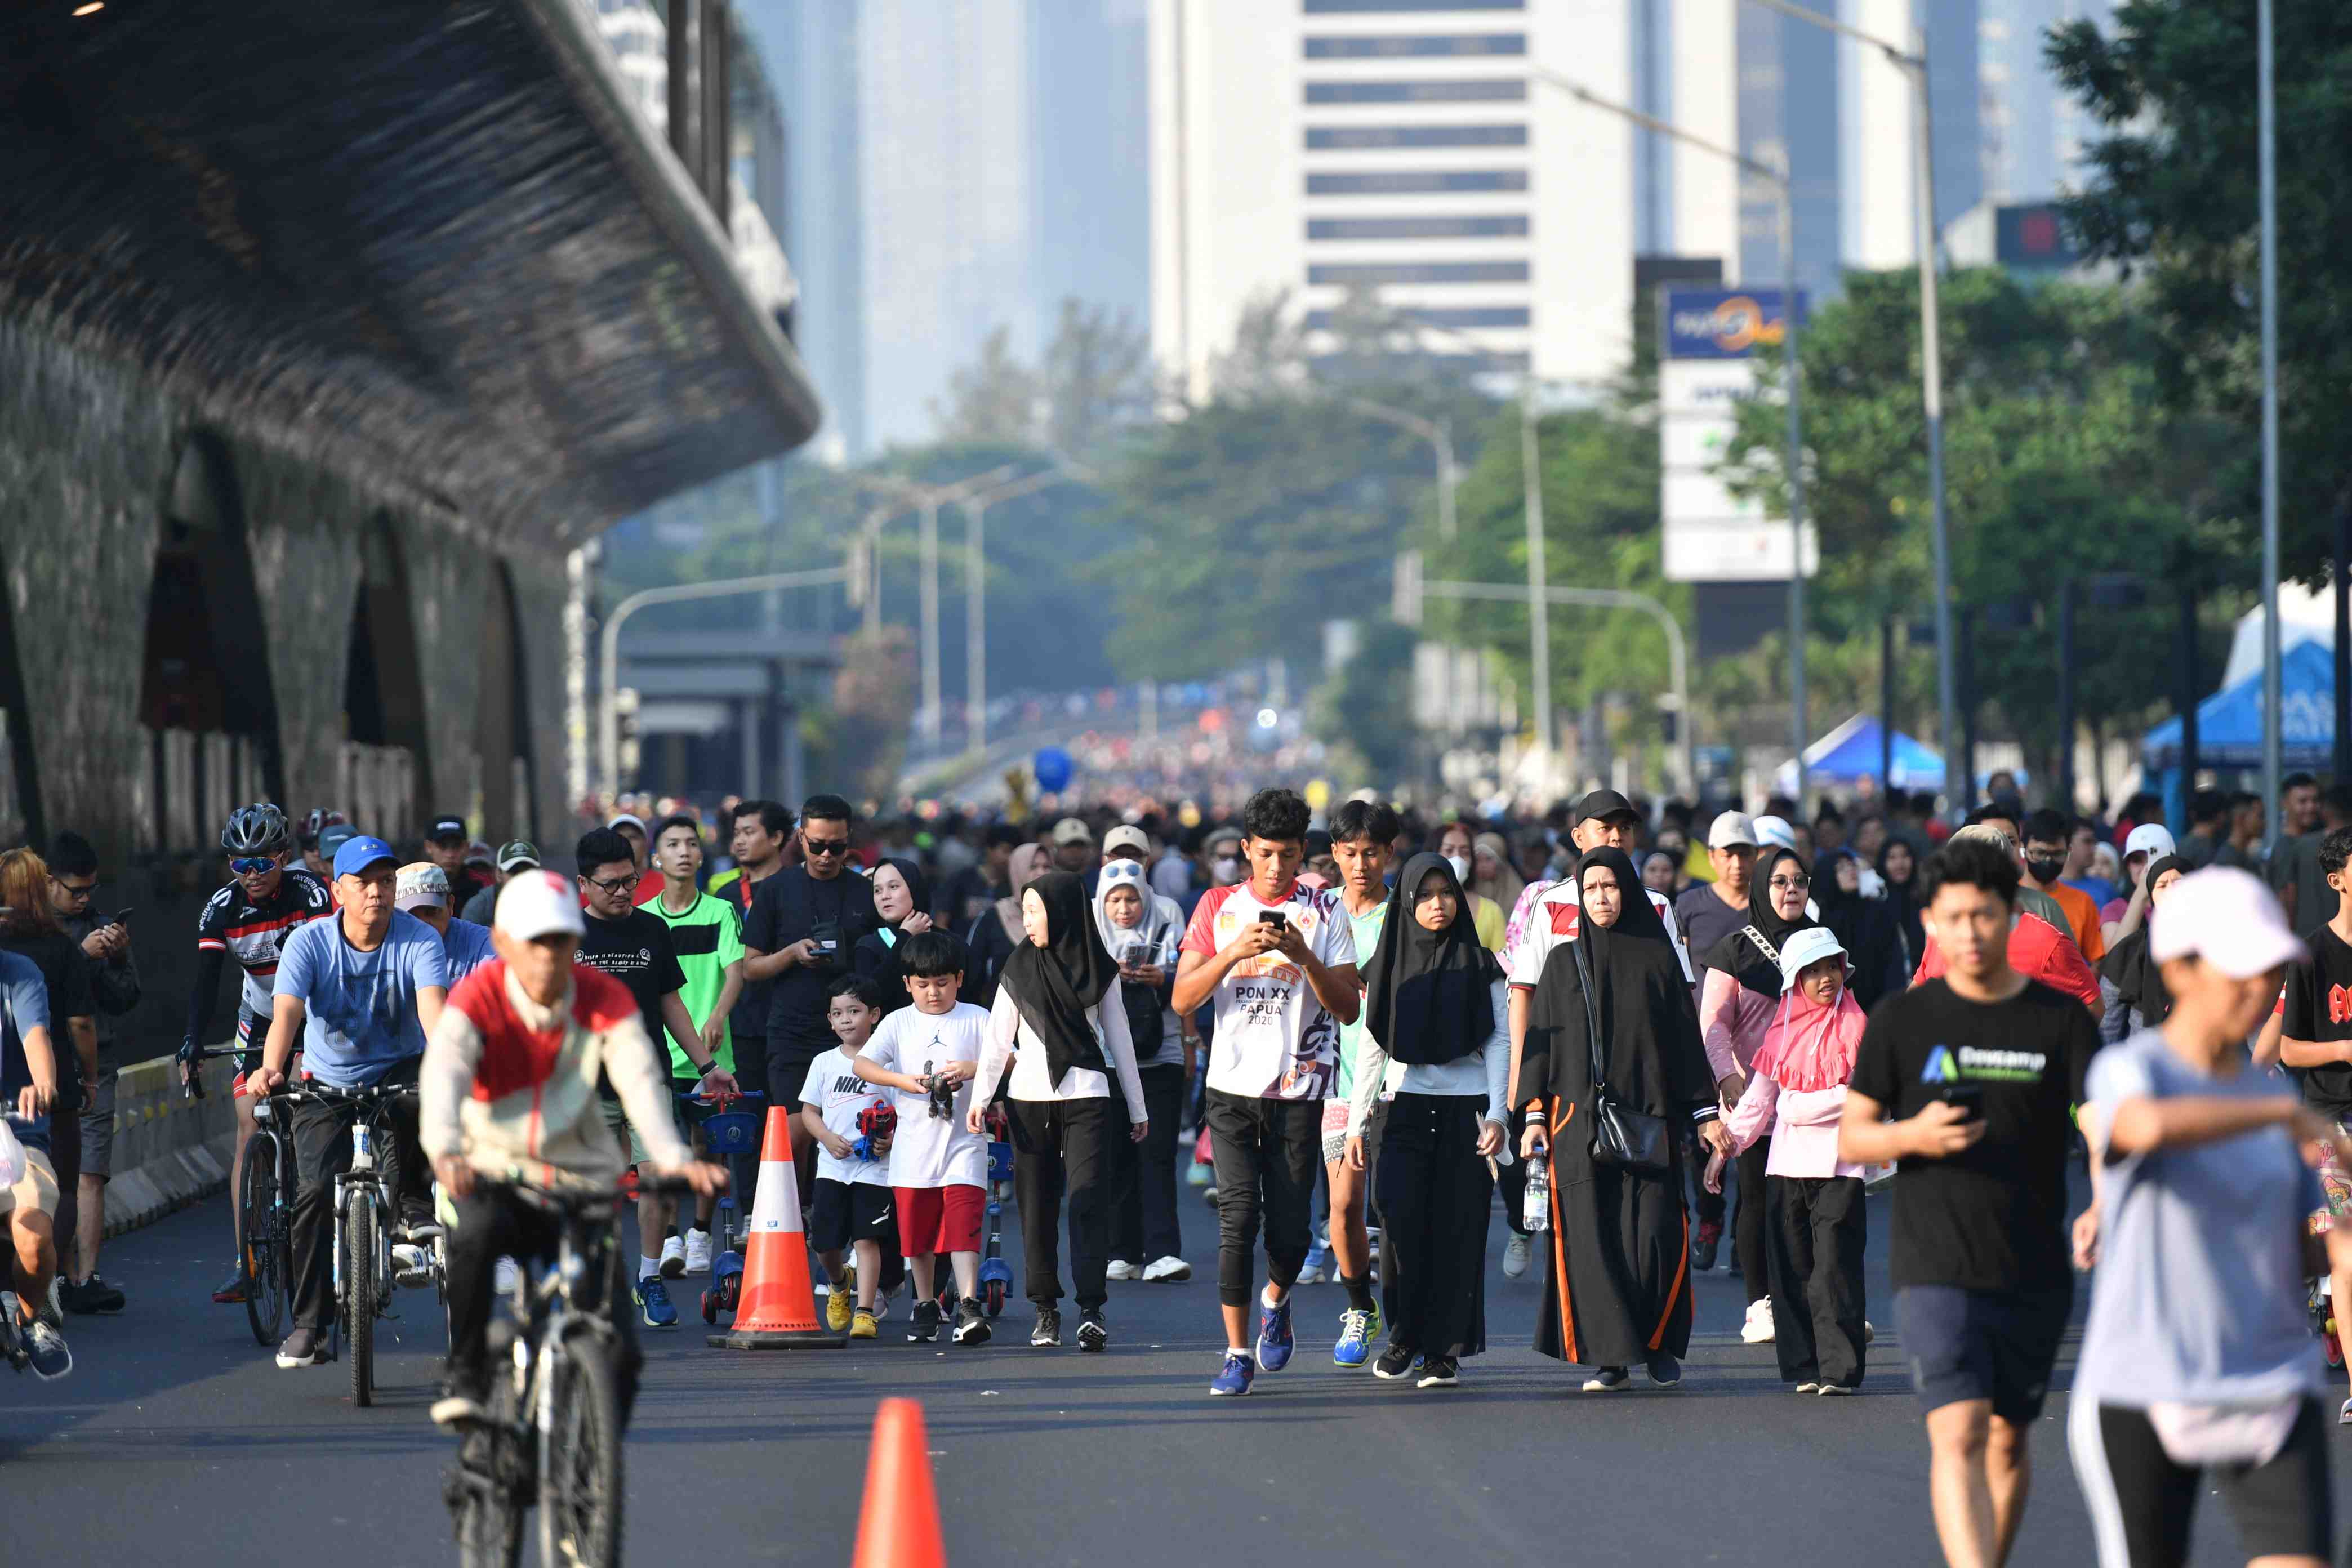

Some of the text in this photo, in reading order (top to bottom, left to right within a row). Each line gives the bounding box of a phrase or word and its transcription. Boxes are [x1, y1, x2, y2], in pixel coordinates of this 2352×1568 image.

[1236, 986, 1290, 1000] PON XX
[1240, 1004, 1282, 1016] PAPUA
[2328, 983, 2352, 1024] A
[1248, 1015, 1273, 1025] 2020
[834, 1076, 867, 1094] NIKE
